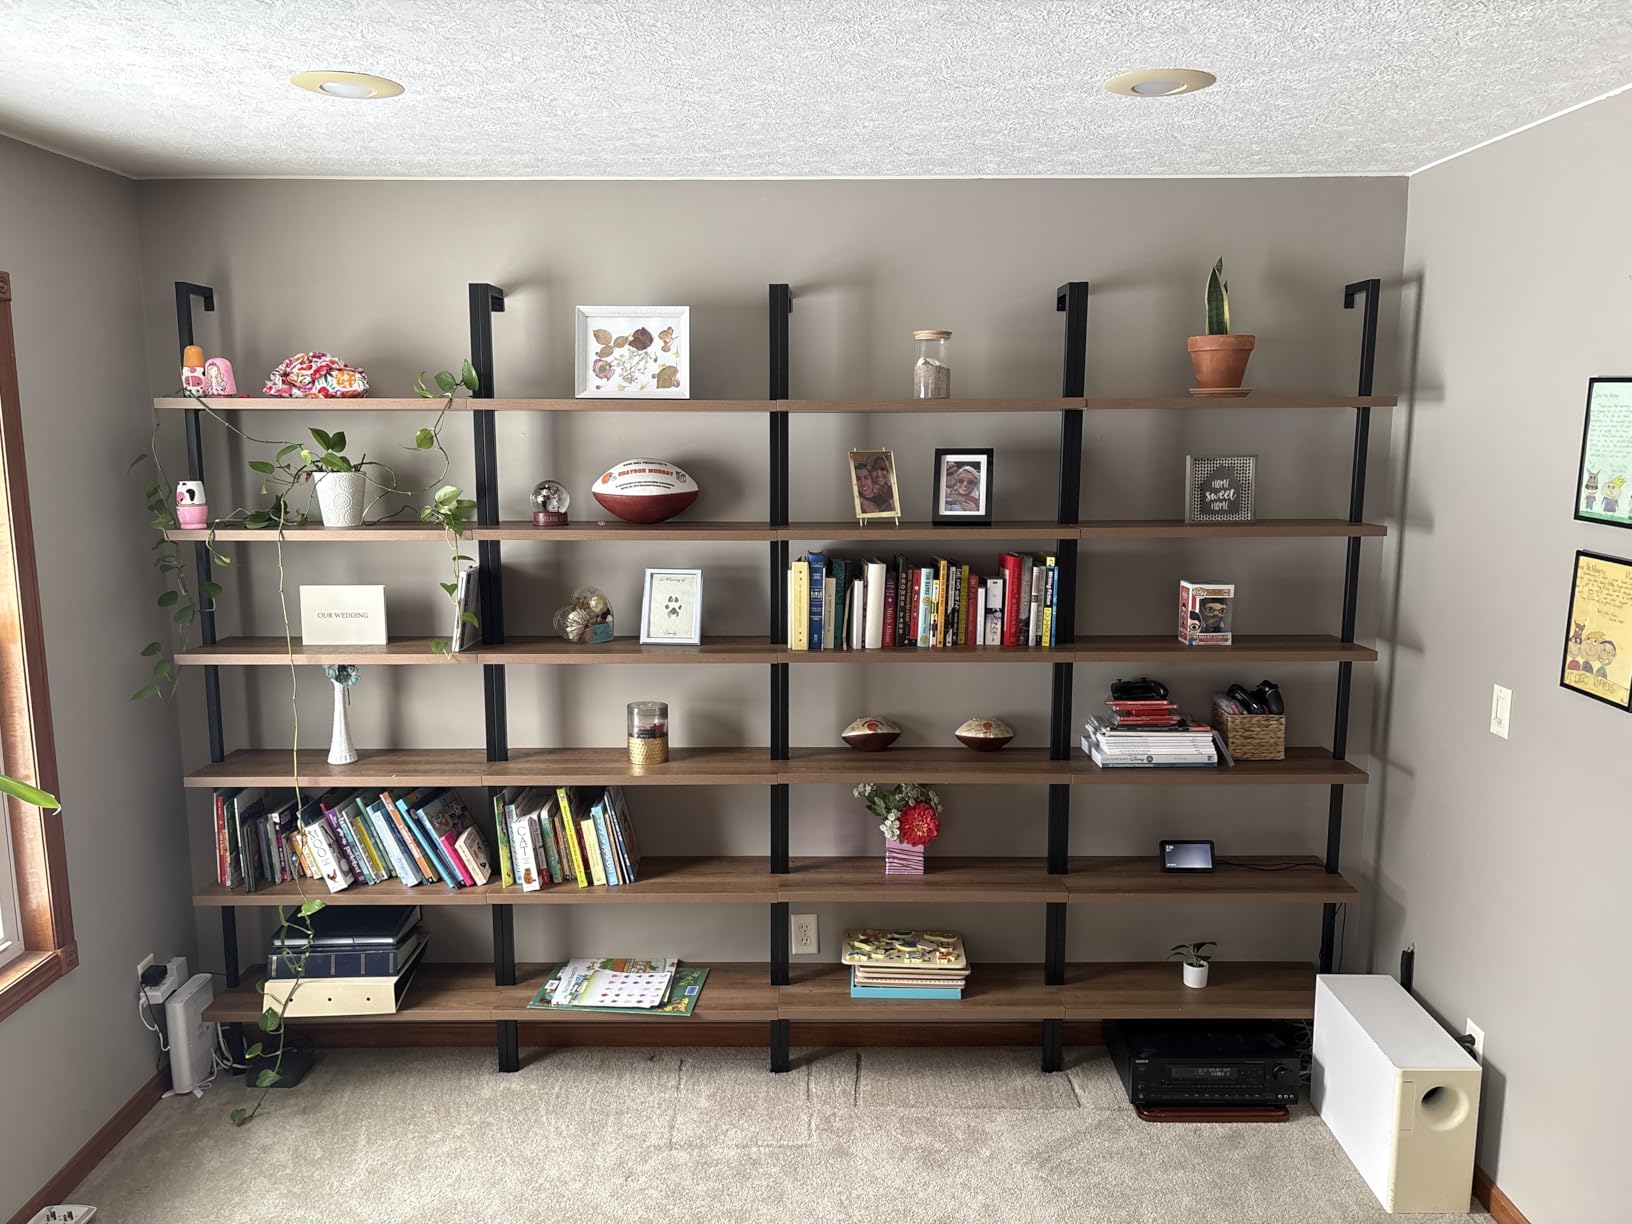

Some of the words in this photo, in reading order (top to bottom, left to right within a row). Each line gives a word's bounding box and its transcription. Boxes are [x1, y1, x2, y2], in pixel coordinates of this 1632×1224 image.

[1211, 478, 1230, 489] HOME
[1205, 488, 1237, 502] sweet
[1210, 501, 1229, 511] HOME
[517, 826, 528, 856] CAT
